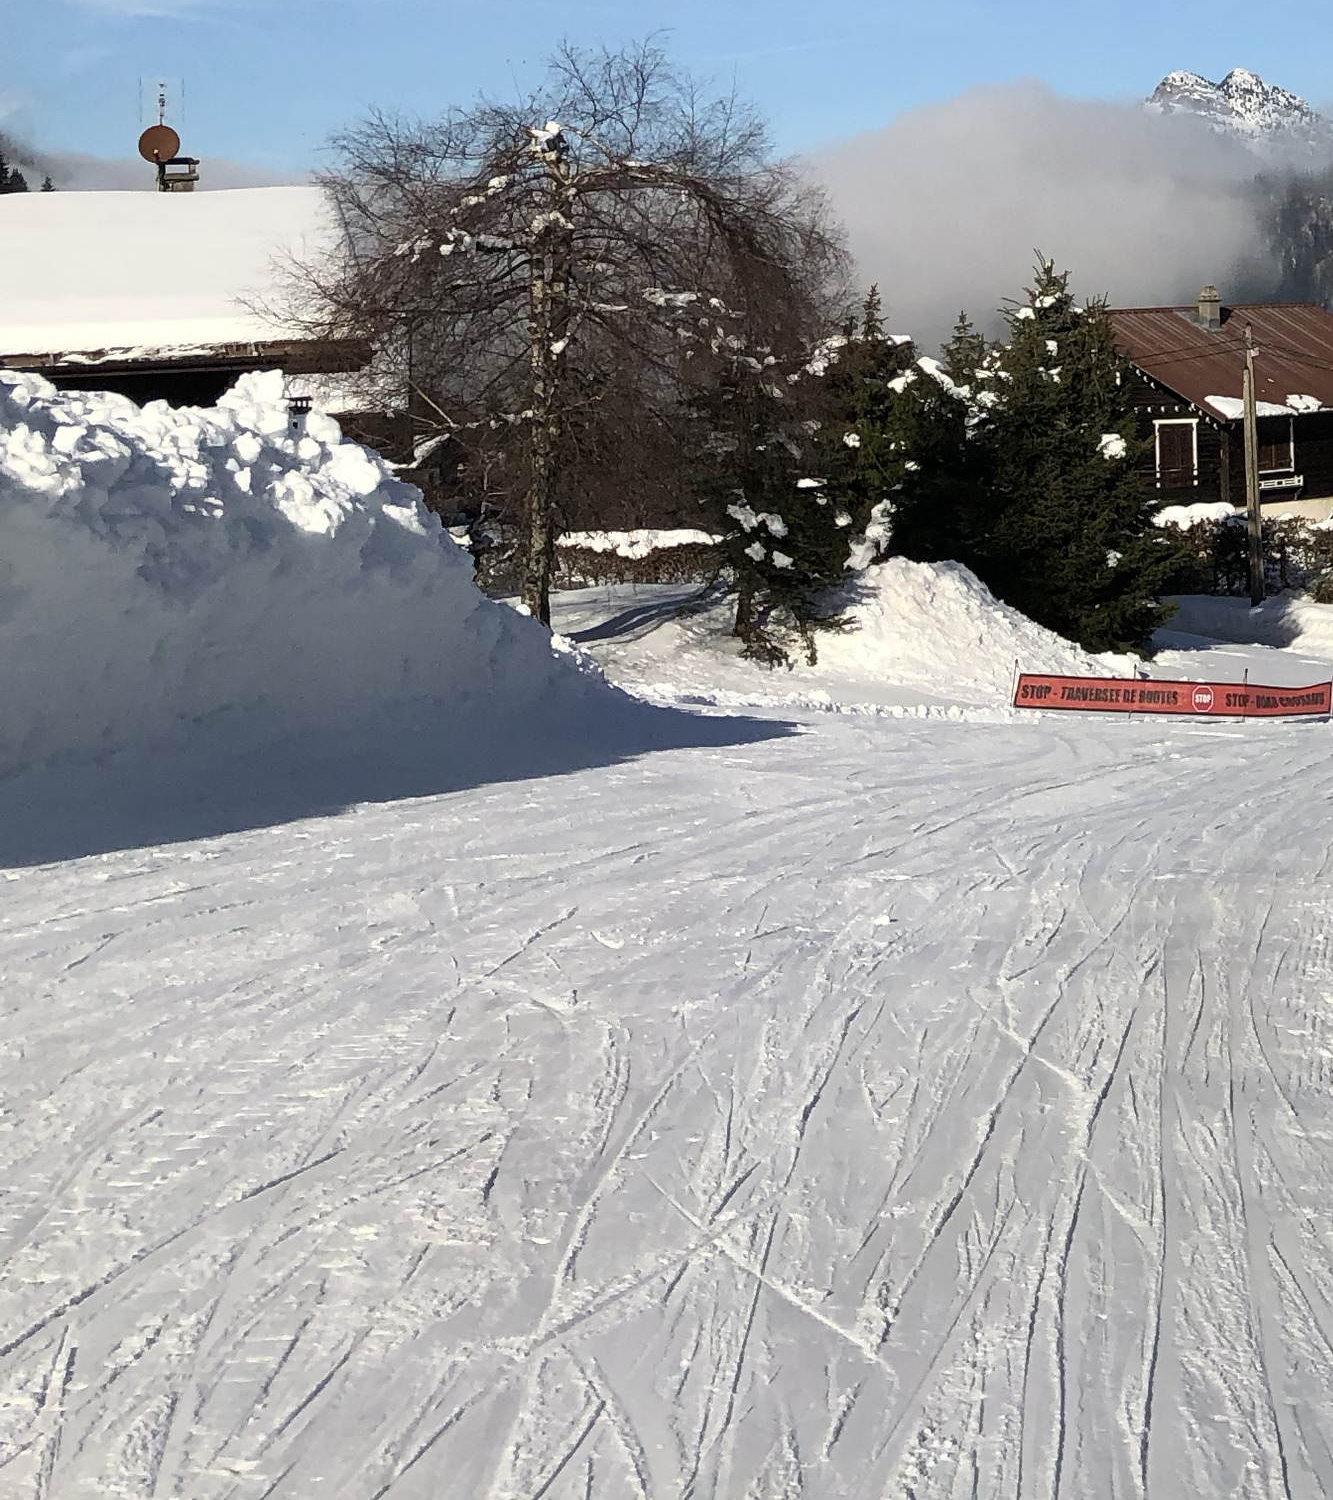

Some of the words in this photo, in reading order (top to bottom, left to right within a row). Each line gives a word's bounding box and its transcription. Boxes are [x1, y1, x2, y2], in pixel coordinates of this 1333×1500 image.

[1021, 684, 1052, 699] STOP
[1123, 688, 1138, 704] DE
[1139, 690, 1179, 705] ROUTES
[1195, 693, 1212, 704] STOP
[1225, 693, 1250, 708] STOP
